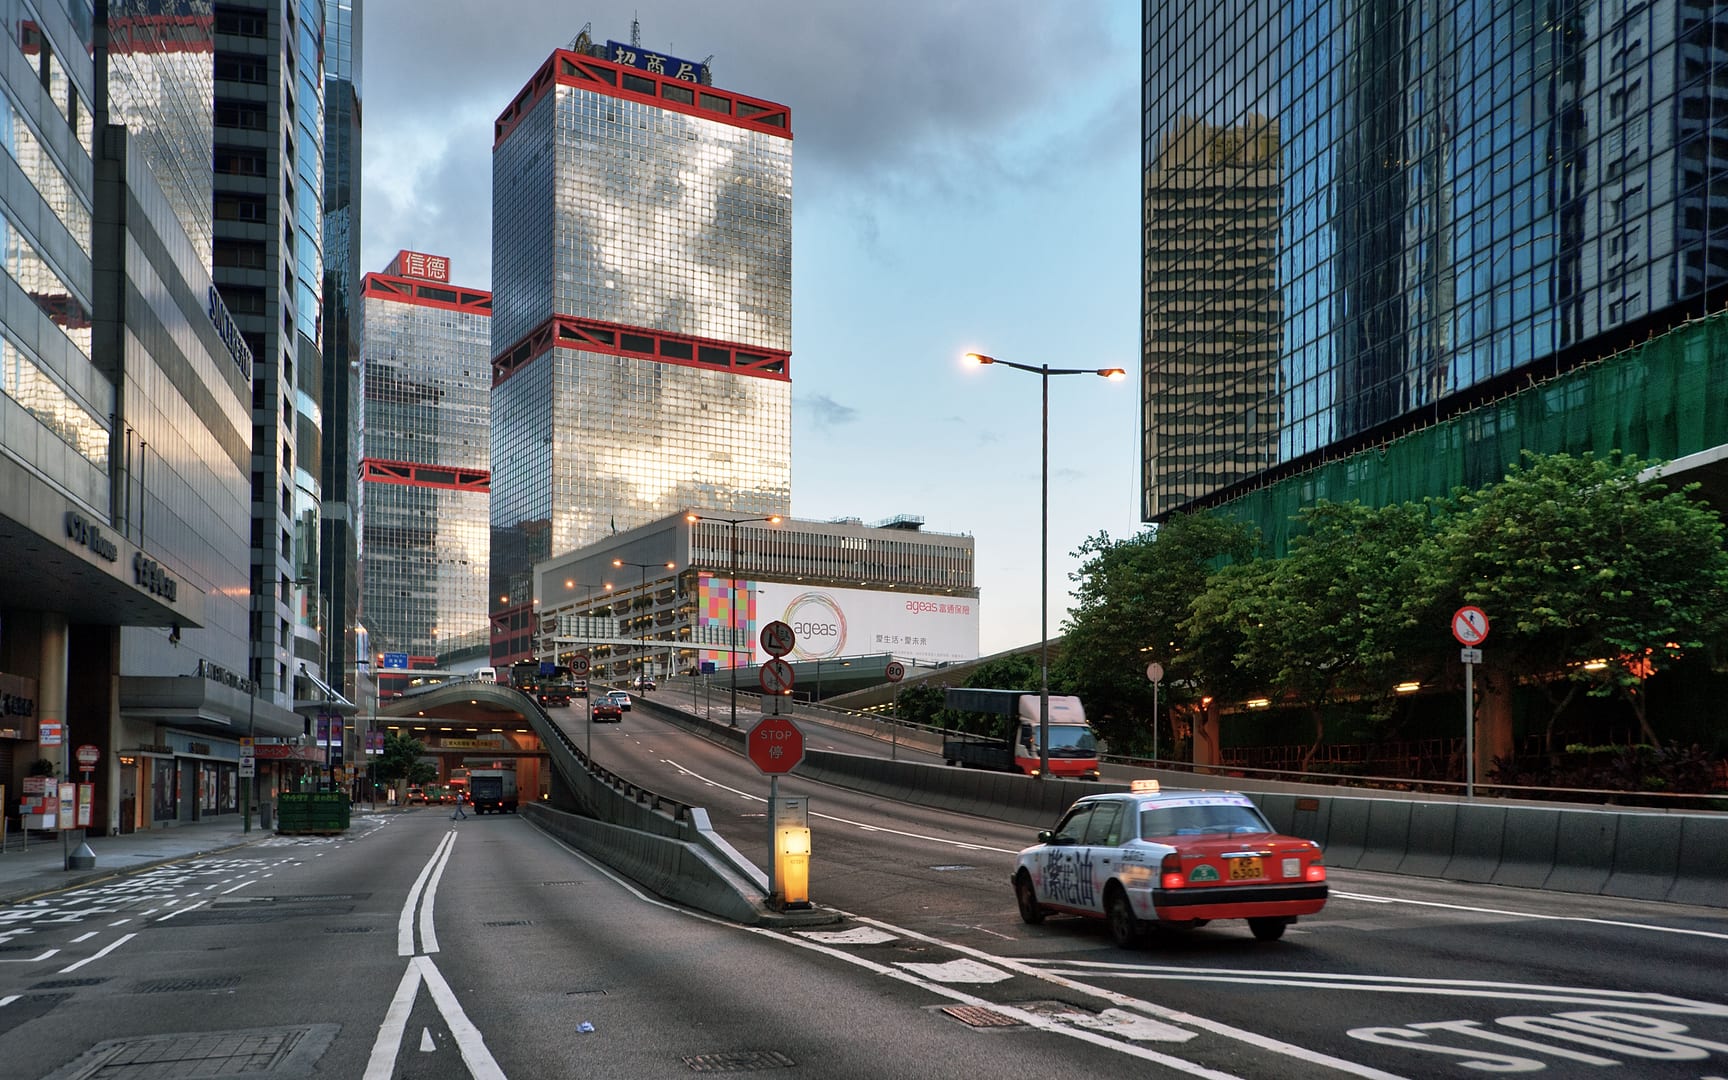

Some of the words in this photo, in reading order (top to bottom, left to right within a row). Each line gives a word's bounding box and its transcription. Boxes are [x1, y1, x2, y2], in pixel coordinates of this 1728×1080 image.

[613, 46, 697, 83] 招商局
[405, 253, 446, 279] 信德
[906, 600, 938, 614] ageas
[794, 621, 838, 640] ageas
[573, 660, 587, 670] 80
[889, 666, 902, 676] 80
[760, 730, 792, 740] STOP
[769, 745, 784, 760] 停
[1346, 1011, 1728, 1072] STOP
